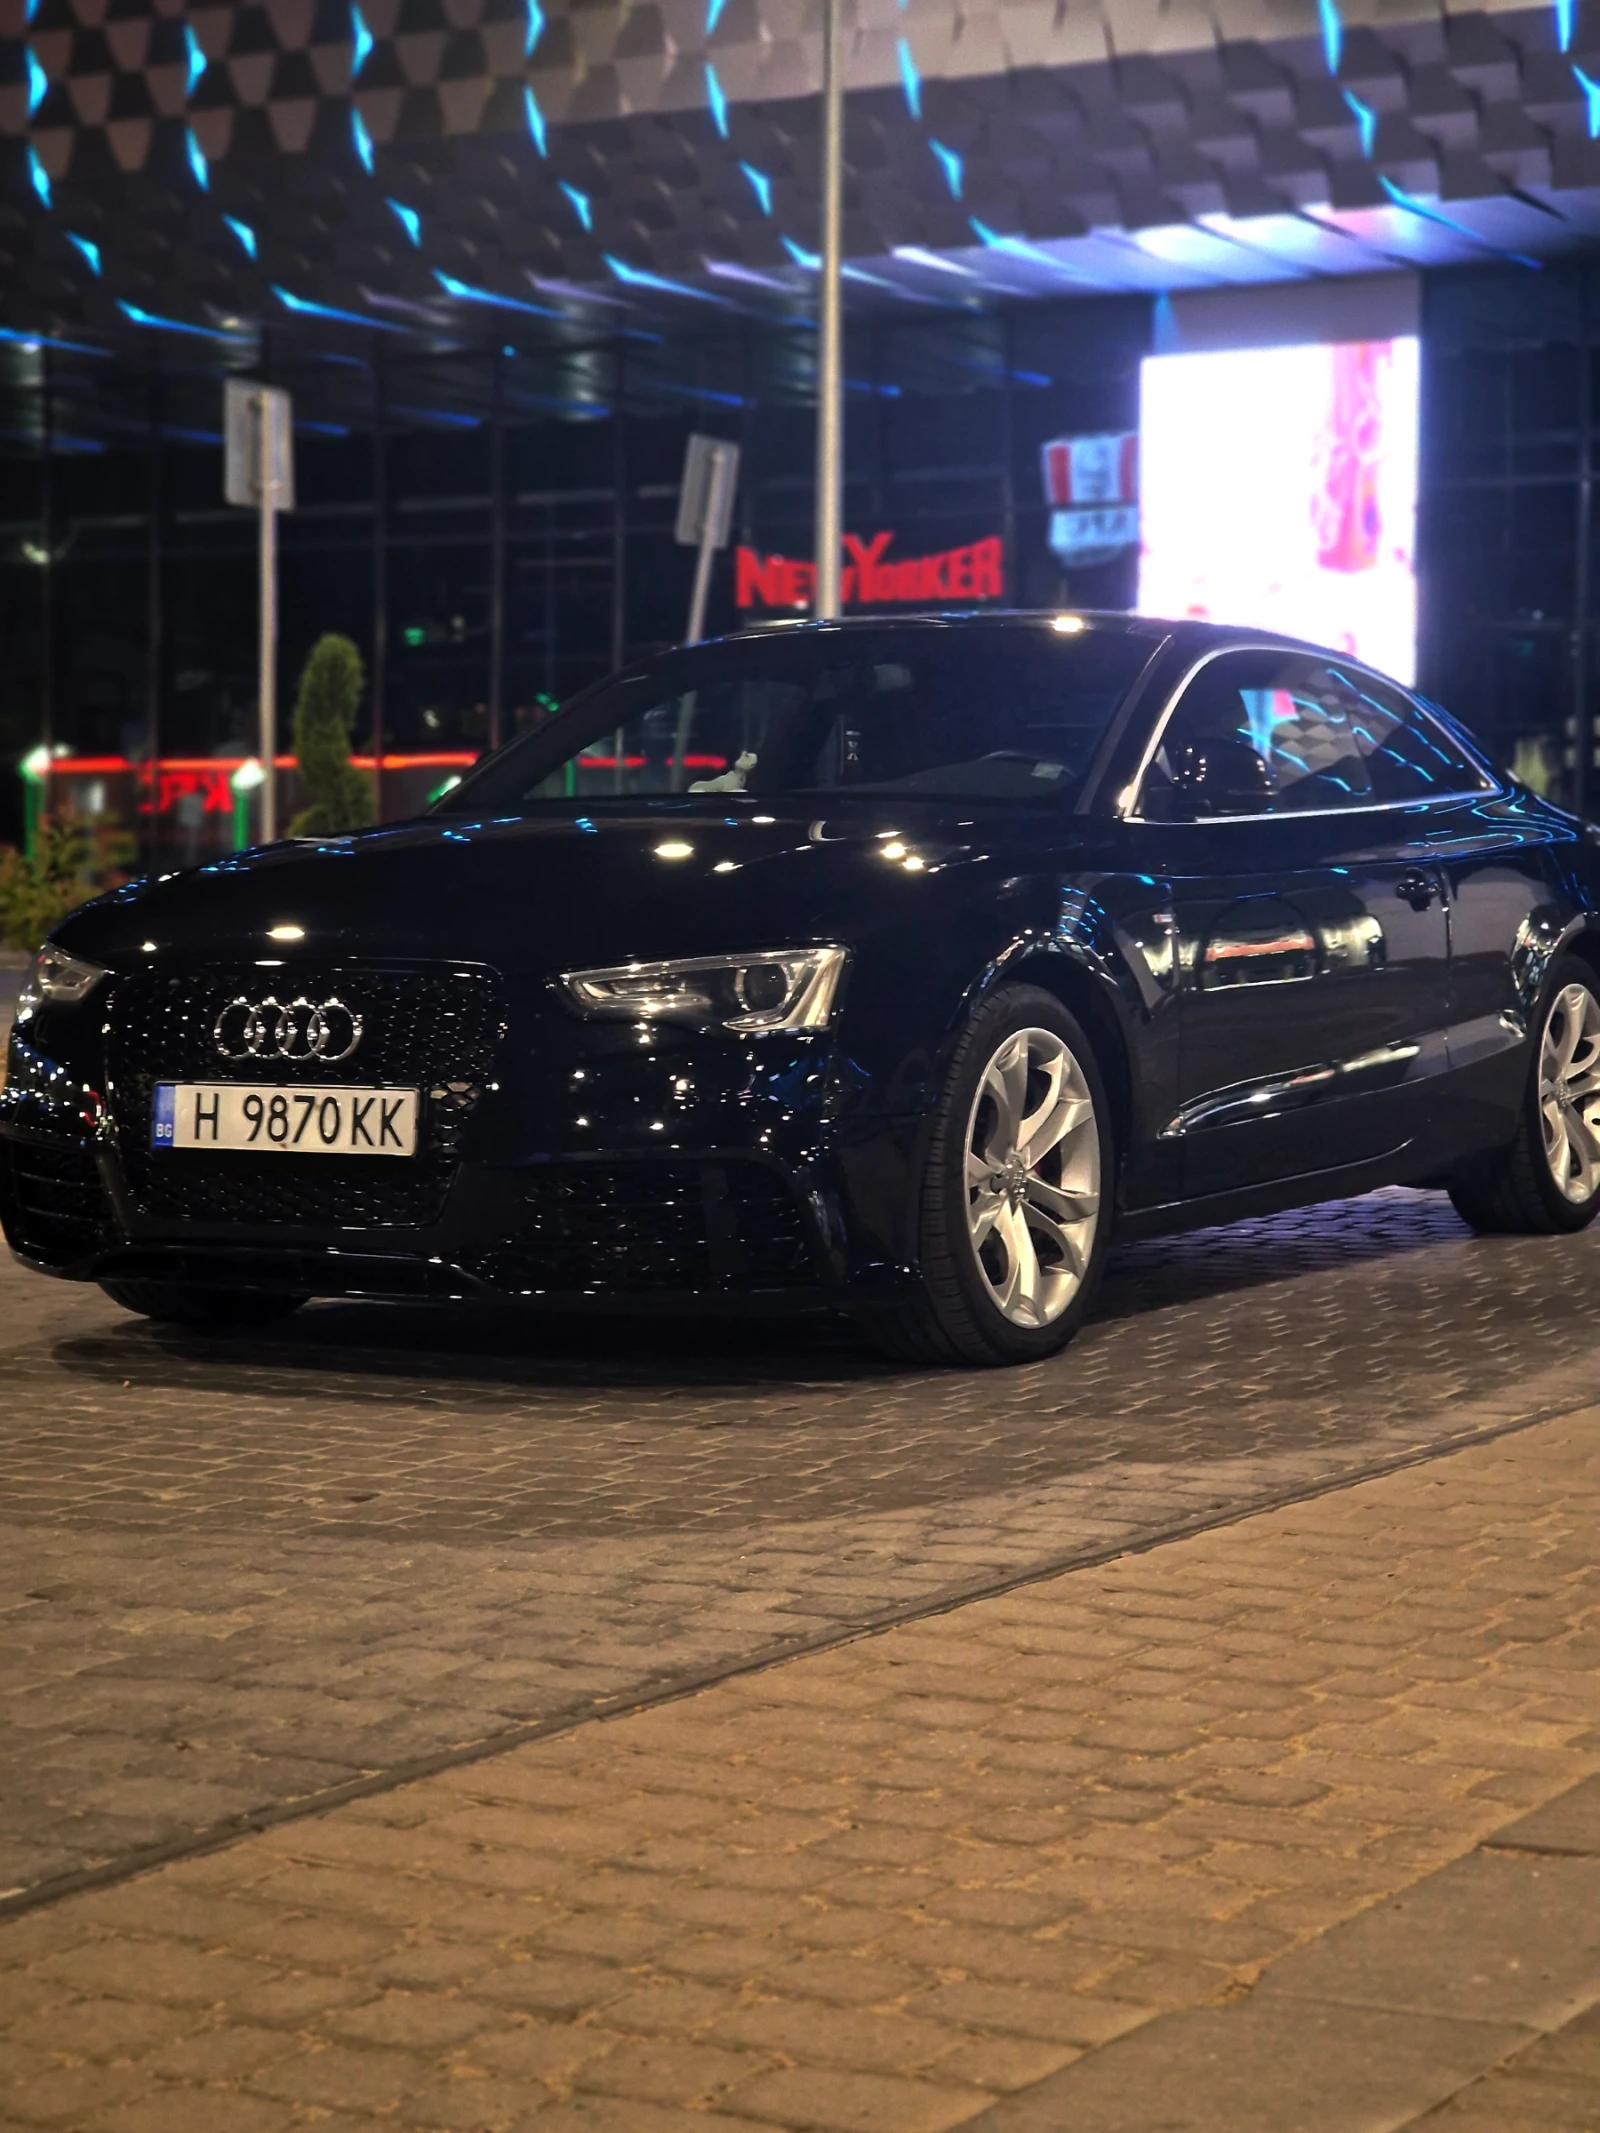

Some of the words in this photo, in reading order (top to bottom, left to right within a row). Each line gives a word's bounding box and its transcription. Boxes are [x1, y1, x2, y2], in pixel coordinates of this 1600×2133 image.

[841, 531, 1003, 603] YORKER
[156, 1122, 173, 1138] BG
[194, 1092, 219, 1140] H
[242, 1094, 340, 1144] 9870
[351, 1096, 405, 1147] KK
